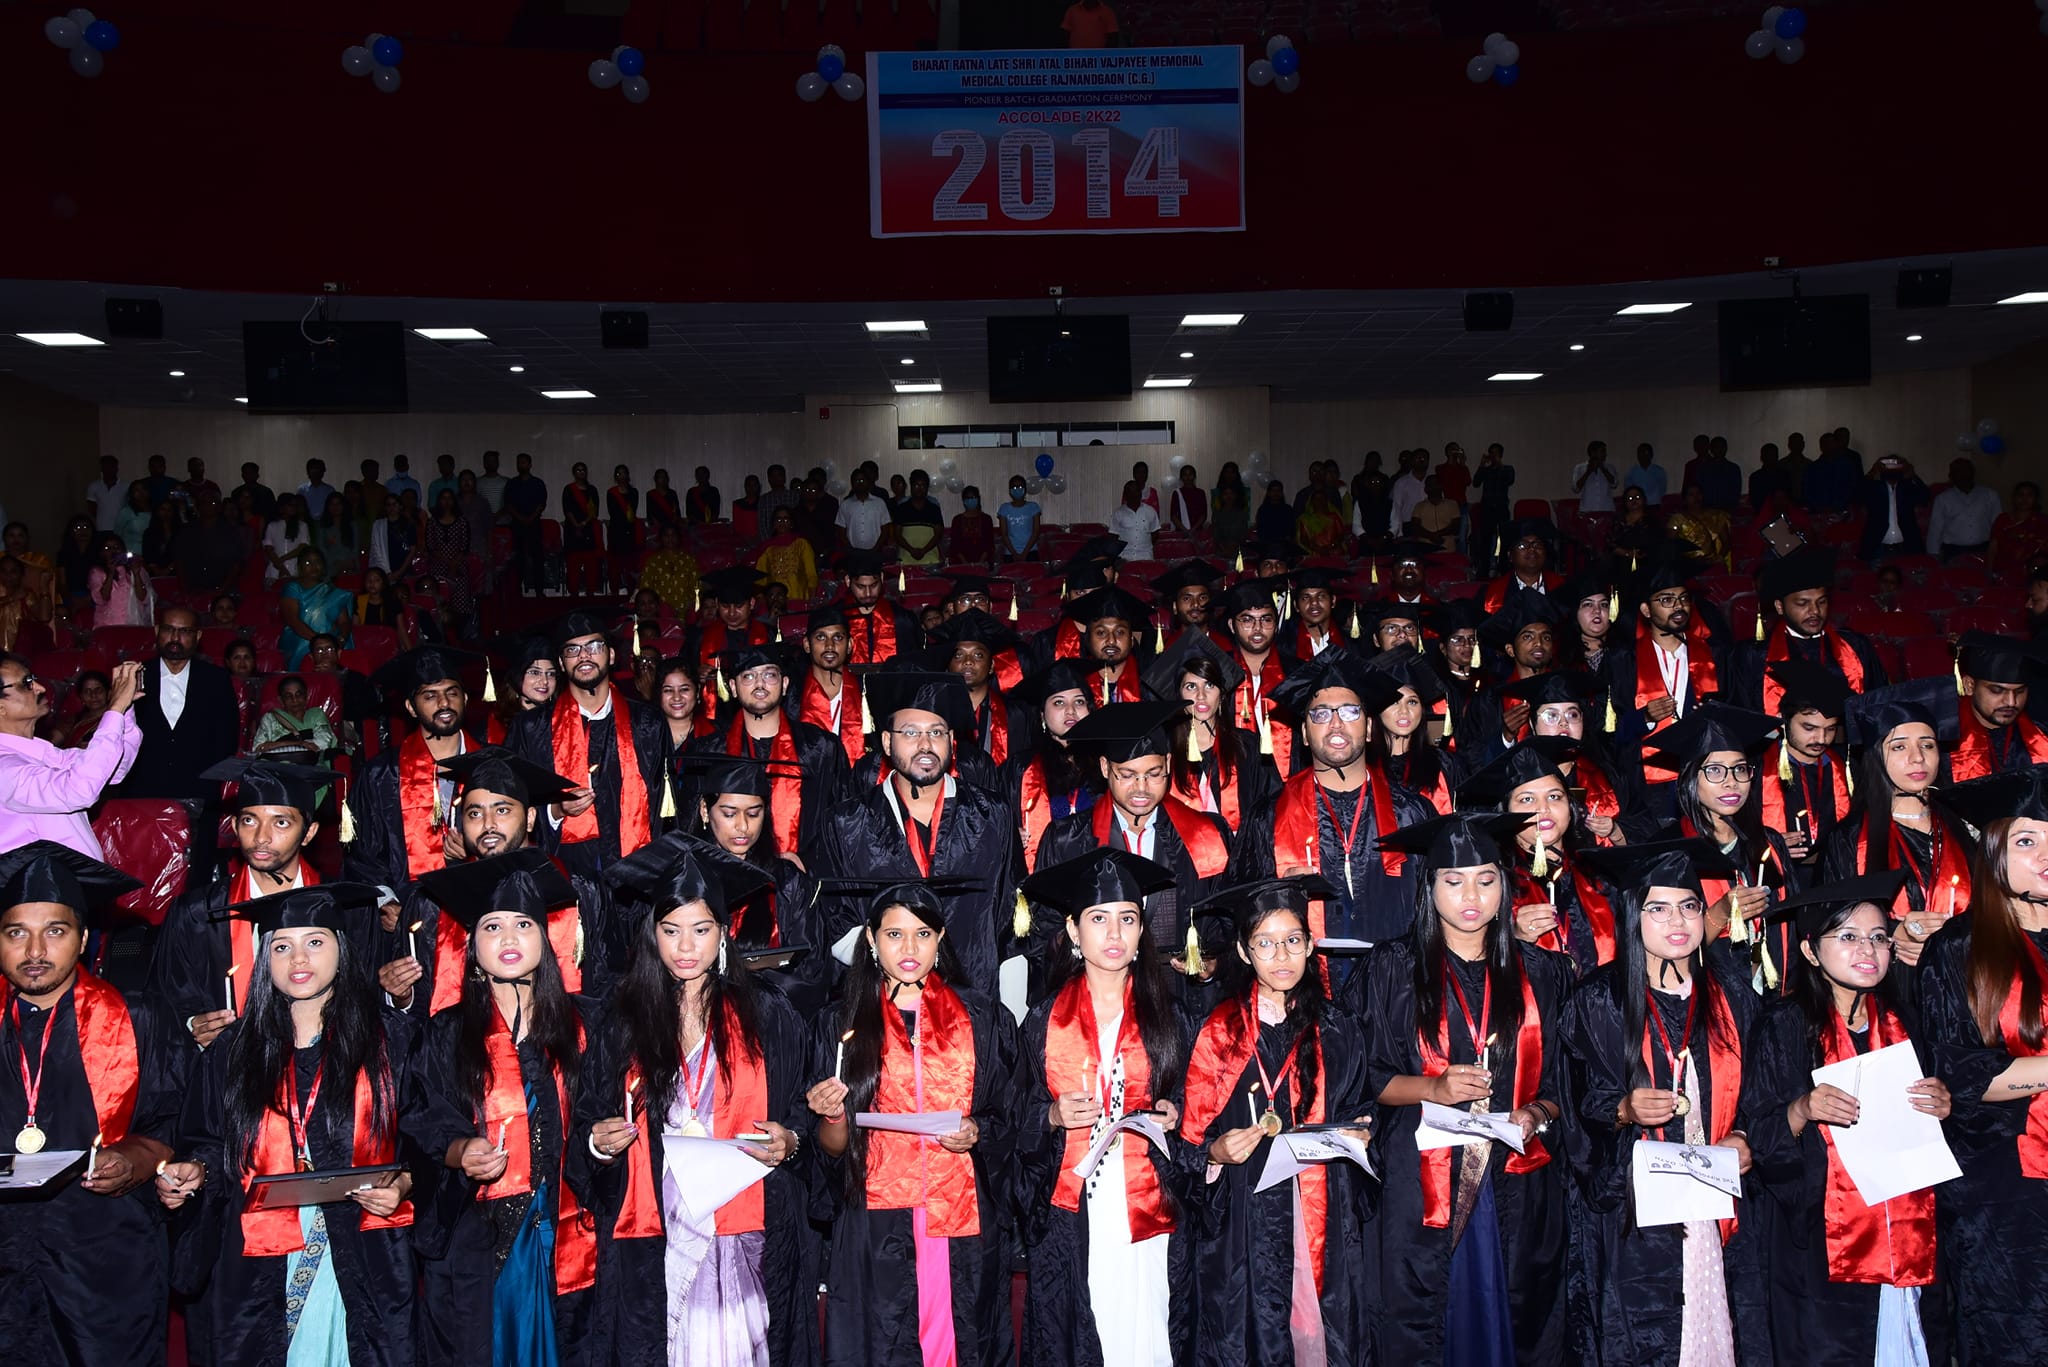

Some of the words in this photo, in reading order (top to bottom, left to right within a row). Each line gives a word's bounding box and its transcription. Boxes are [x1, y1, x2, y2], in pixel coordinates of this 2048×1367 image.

[912, 58, 949, 71] BHARAT
[952, 58, 985, 71] RATNA
[988, 58, 1009, 70] LATE
[1012, 58, 1036, 70] SHRI
[1039, 57, 1061, 70] ATAL
[1064, 57, 1097, 69] BIHARI
[1100, 56, 1147, 69] VAJPAYEE
[1150, 55, 1204, 67] MEMORIAL
[961, 75, 1005, 87] MEDICAL
[1007, 74, 1048, 87] COLLEGE
[1050, 73, 1125, 86] RAJNANDGAON
[1128, 72, 1156, 85] (C.G.)
[964, 96, 1001, 105] PIONEER
[1004, 96, 1036, 104] BATCH
[1038, 95, 1101, 104] GRADUATION
[1103, 94, 1153, 103] CEREMONY
[998, 111, 1082, 124] ACCOLADE
[1086, 110, 1121, 122] 2K22
[931, 127, 1189, 221] 2014
